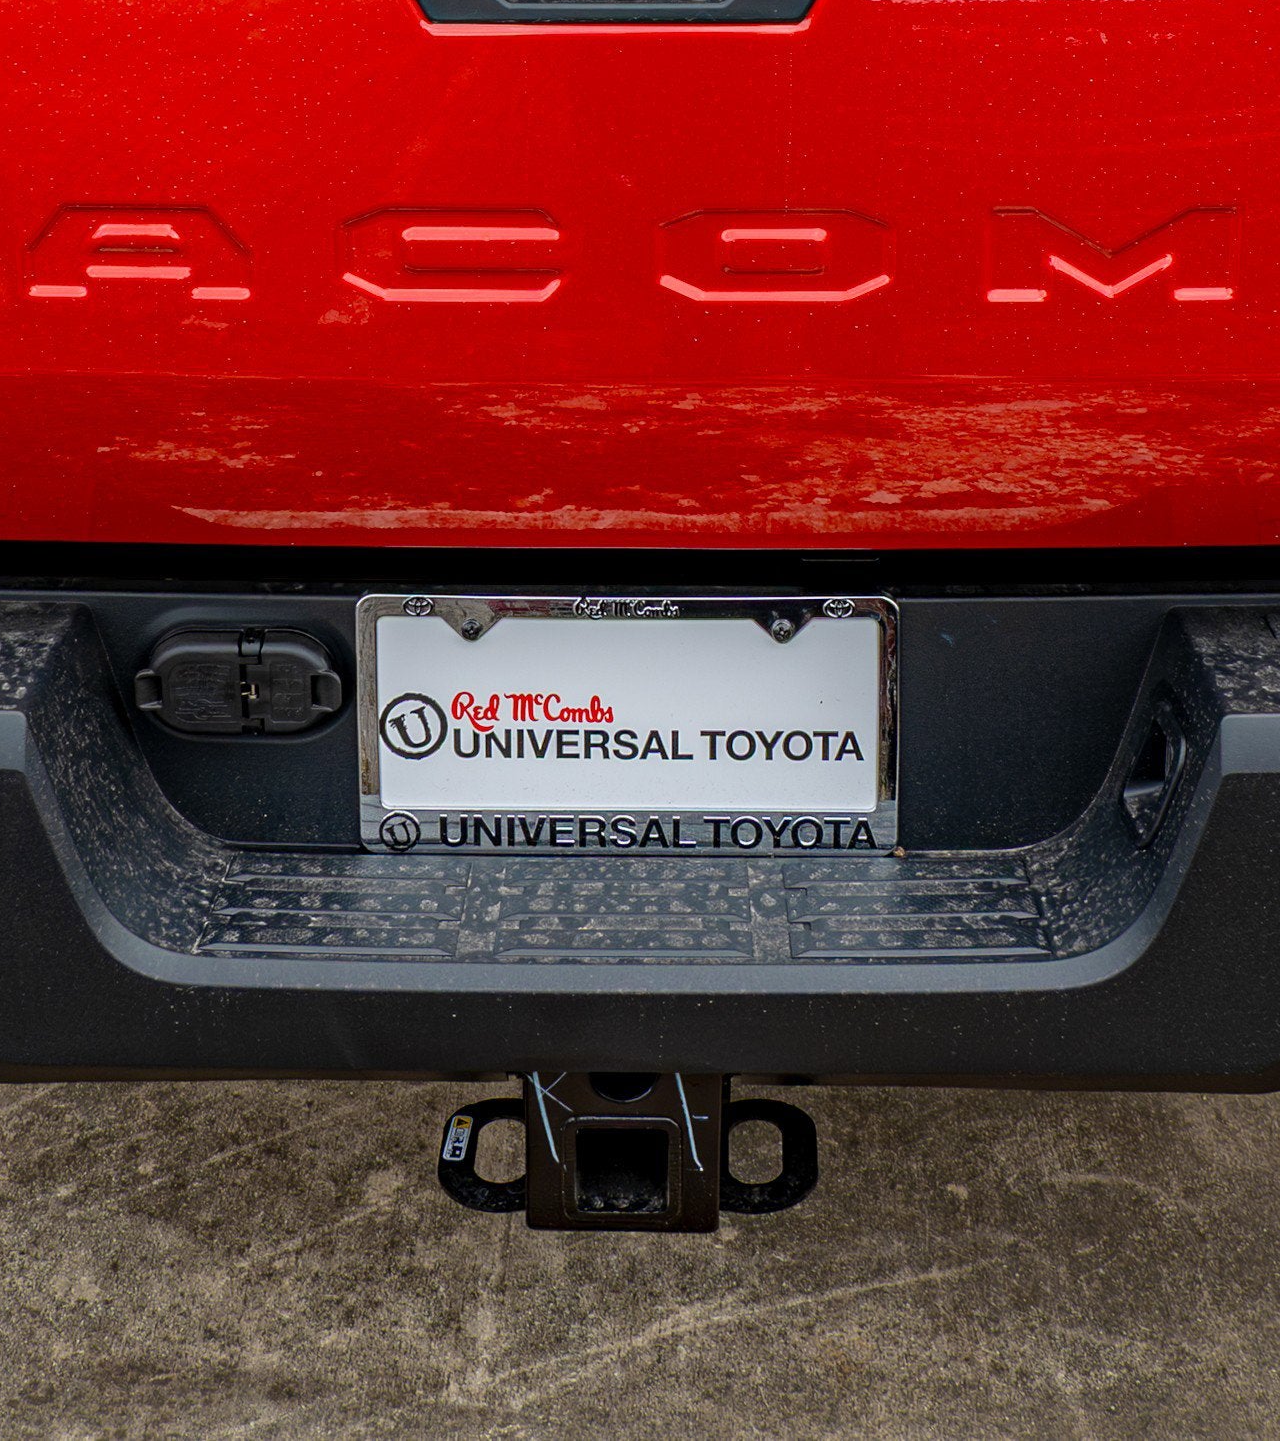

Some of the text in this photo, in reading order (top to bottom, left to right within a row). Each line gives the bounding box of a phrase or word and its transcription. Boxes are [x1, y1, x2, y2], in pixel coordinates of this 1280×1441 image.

[573, 596, 681, 619] Red McCombs
[451, 691, 615, 732] Red McCombs
[452, 729, 865, 761] UNIVERSAL TOYOTA
[438, 814, 879, 850] UNIVERSAL TOYOTA
